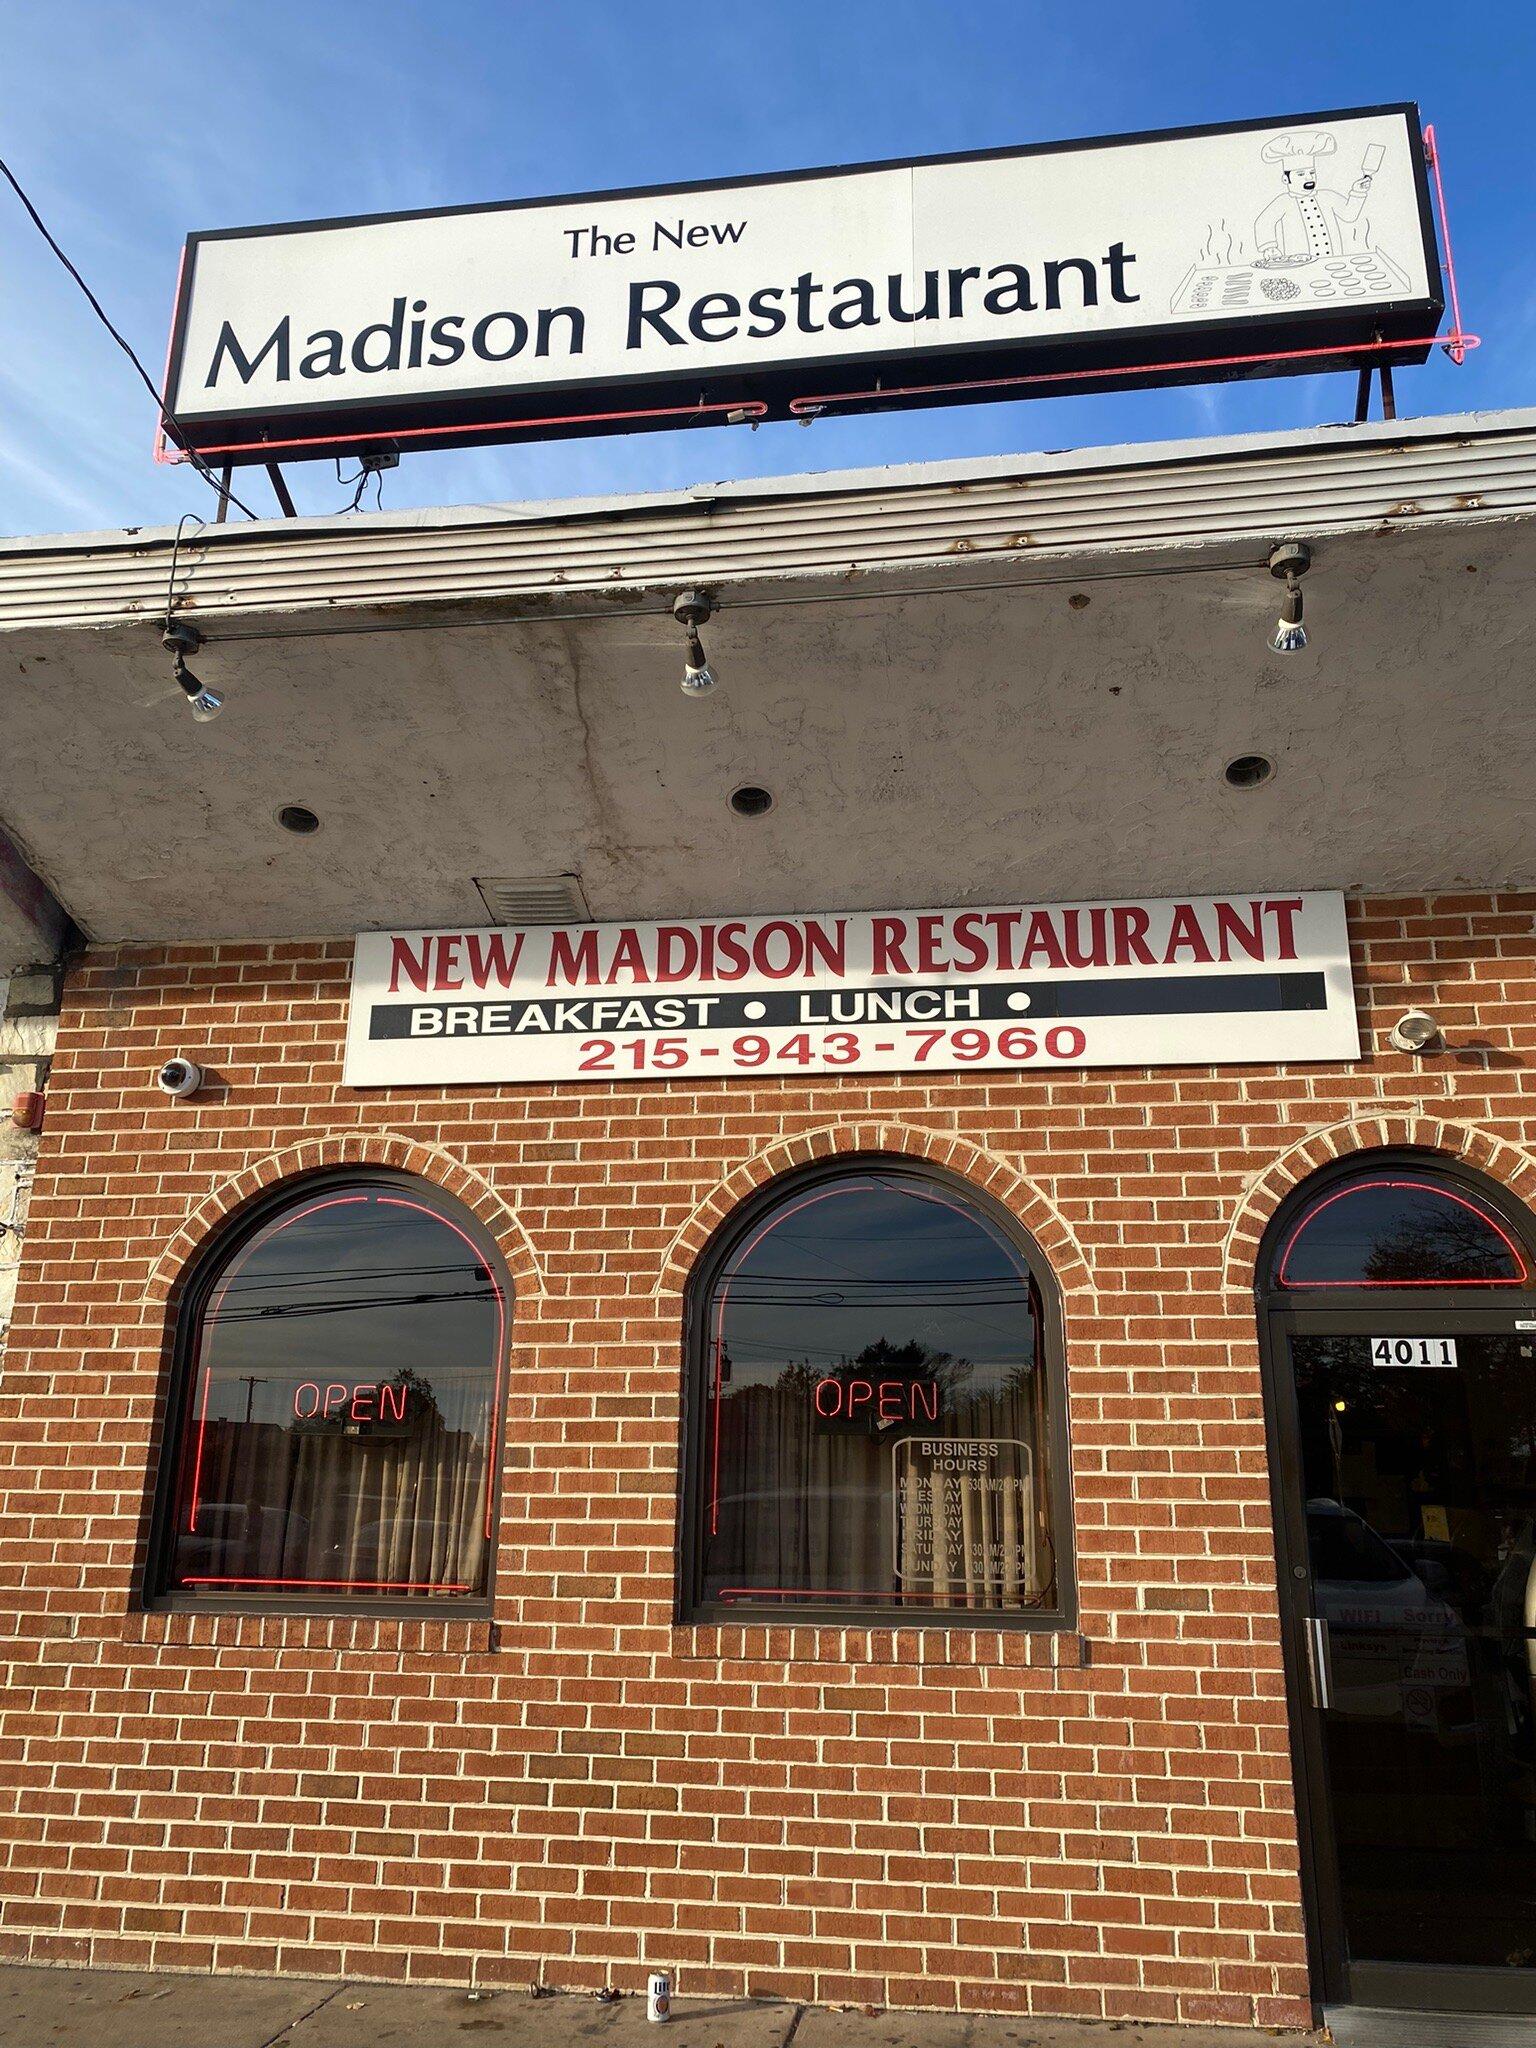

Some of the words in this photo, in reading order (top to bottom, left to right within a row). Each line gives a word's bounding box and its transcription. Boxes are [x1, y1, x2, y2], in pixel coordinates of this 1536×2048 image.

[563, 225, 637, 259] The
[652, 219, 748, 252] New
[204, 296, 586, 389] Madison
[625, 241, 1140, 351] Restaurant
[387, 932, 526, 993] NEW
[545, 919, 848, 987] MADISON
[871, 899, 1304, 976] RESTAURANT
[410, 997, 720, 1037] BREAKFAST
[800, 988, 981, 1023] LUNCH
[578, 1025, 1088, 1072] 215-943-7960
[1374, 1339, 1453, 1366] 4011
[294, 1382, 408, 1420] OPEN
[815, 1378, 938, 1420] OPEN
[921, 1442, 999, 1457] BUSINESS
[933, 1459, 988, 1472] HOURS
[900, 1477, 962, 1489] MONAY
[900, 1490, 962, 1502] TESAY
[900, 1502, 963, 1515] WDNEDAY
[900, 1515, 963, 1528] TURSDAY
[901, 1543, 964, 1555] SATUDAY
[902, 1560, 958, 1573] UNDAY
[1403, 1664, 1436, 1679] Cash
[1438, 1666, 1468, 1683] Only
